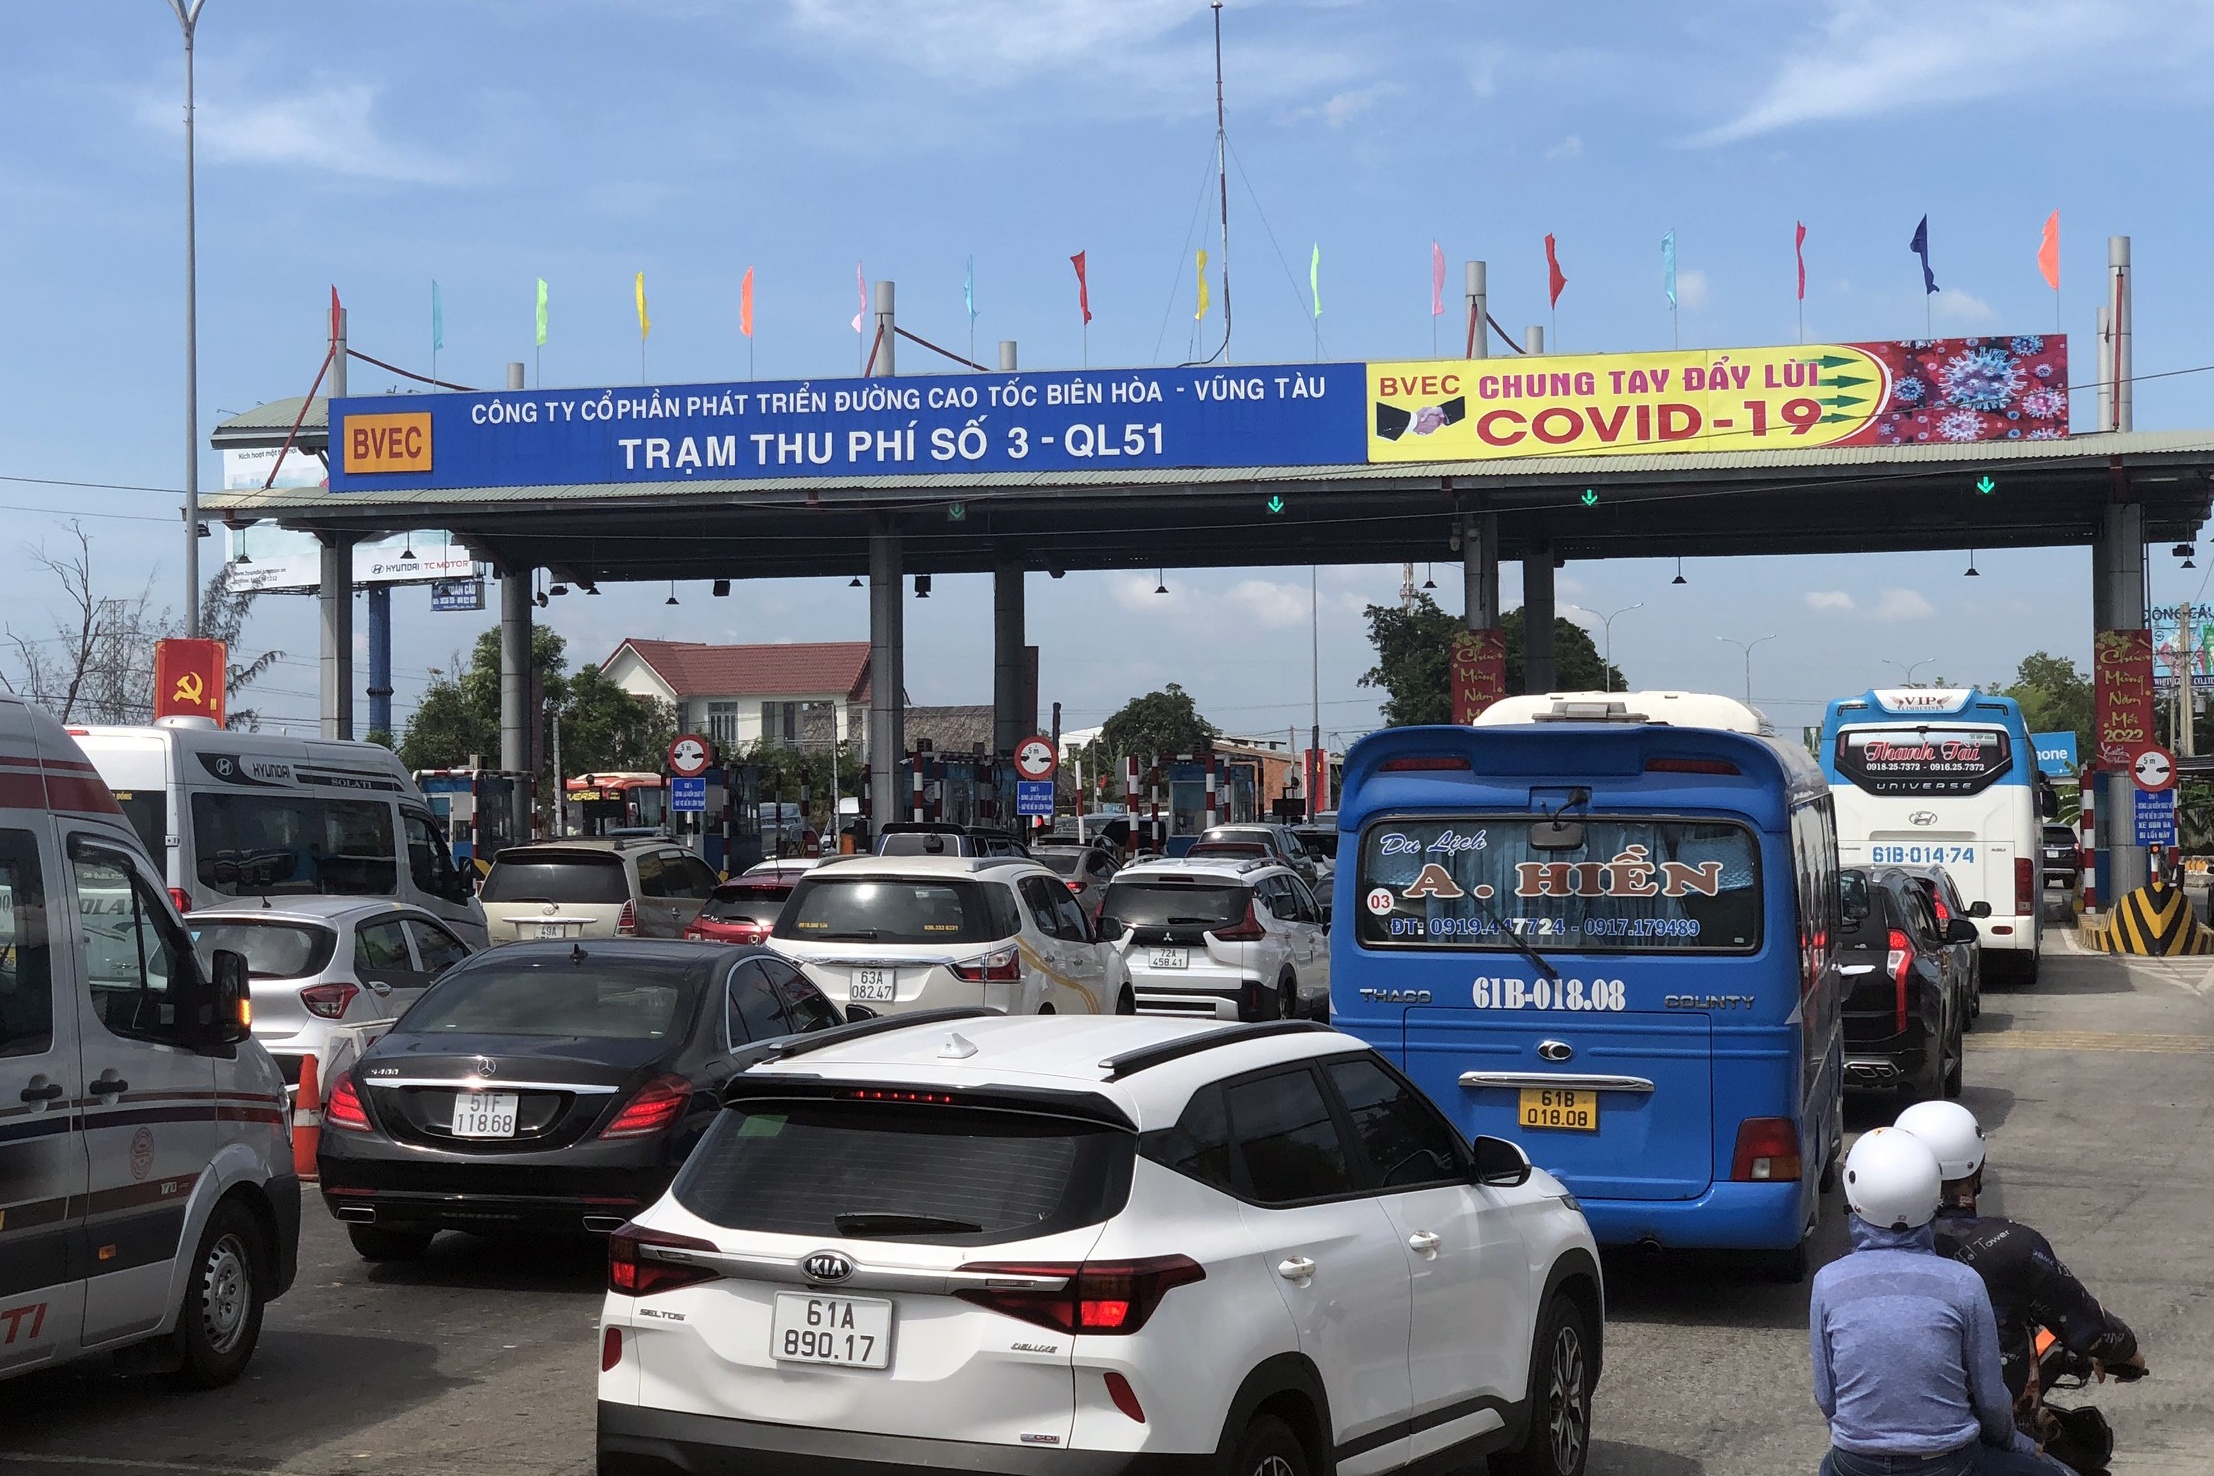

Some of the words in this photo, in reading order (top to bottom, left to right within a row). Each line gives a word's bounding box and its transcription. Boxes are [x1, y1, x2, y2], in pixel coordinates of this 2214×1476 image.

[1380, 374, 1460, 397] BVEC
[1478, 371, 1595, 399] CHUNG
[1608, 369, 1670, 394] TAY
[1682, 356, 1751, 392] ĐẨY
[1764, 358, 1819, 388] LÙI
[472, 397, 538, 425] CÔNG
[545, 401, 575, 422] TY
[581, 389, 613, 421] CỔ
[617, 388, 680, 419] PHẦN
[687, 389, 748, 417] PHÁT
[756, 382, 827, 414] TRIỂN
[835, 383, 920, 412] ĐƯỜNG
[928, 386, 978, 409] CAO
[988, 377, 1038, 407] TỐC
[1047, 378, 1102, 405] BIÊN
[1111, 376, 1163, 403] HÒA
[1194, 374, 1265, 401] VŨNG
[1274, 372, 1326, 399] TÀU
[353, 426, 422, 460] BVEC
[618, 435, 736, 475] TRẠM
[750, 432, 833, 465] THU
[849, 420, 918, 462] PHÍ
[931, 414, 988, 460] SỐ
[1007, 427, 1029, 459] 3
[1064, 423, 1163, 458] QL51
[437, 560, 469, 569] MOTOR
[1460, 668, 1497, 692] Mừng
[2105, 670, 2145, 696] Mừng
[1464, 687, 1494, 703] Năm
[1904, 696, 1937, 706] VIP
[2109, 691, 2141, 707] Năm
[2112, 711, 2140, 728] Mới
[2103, 729, 2144, 742] 2022
[1863, 741, 1935, 761] Thanh
[1940, 740, 1981, 761] Tài
[252, 762, 290, 779] HYUNDAI
[331, 778, 372, 789] SOLATI
[1876, 782, 1972, 790] UNIVERSE
[1380, 833, 1421, 855] Du
[1426, 829, 1487, 856] Lịch
[1371, 894, 1391, 910] 03
[1391, 918, 1424, 935] ĐT:
[1583, 917, 1700, 937] 0917.179489
[1160, 949, 1177, 957] 72A
[1152, 958, 1182, 966] 458.41
[860, 971, 883, 985] 63A
[852, 986, 892, 999] 082.47
[1360, 988, 1432, 1003] THACO
[1472, 976, 1626, 1011] 61B-018.08
[1664, 994, 1755, 1010] COUNTY
[470, 1093, 503, 1112] 51F
[1541, 1091, 1575, 1108] 61B
[458, 1113, 512, 1133] 118.68
[1527, 1108, 1588, 1126] 018.08
[811, 1258, 842, 1276] KIA
[639, 1308, 686, 1321] SELTOS
[807, 1300, 854, 1329] 61A
[784, 1329, 875, 1362] 890.17
[1010, 1342, 1058, 1354] DELUXE
